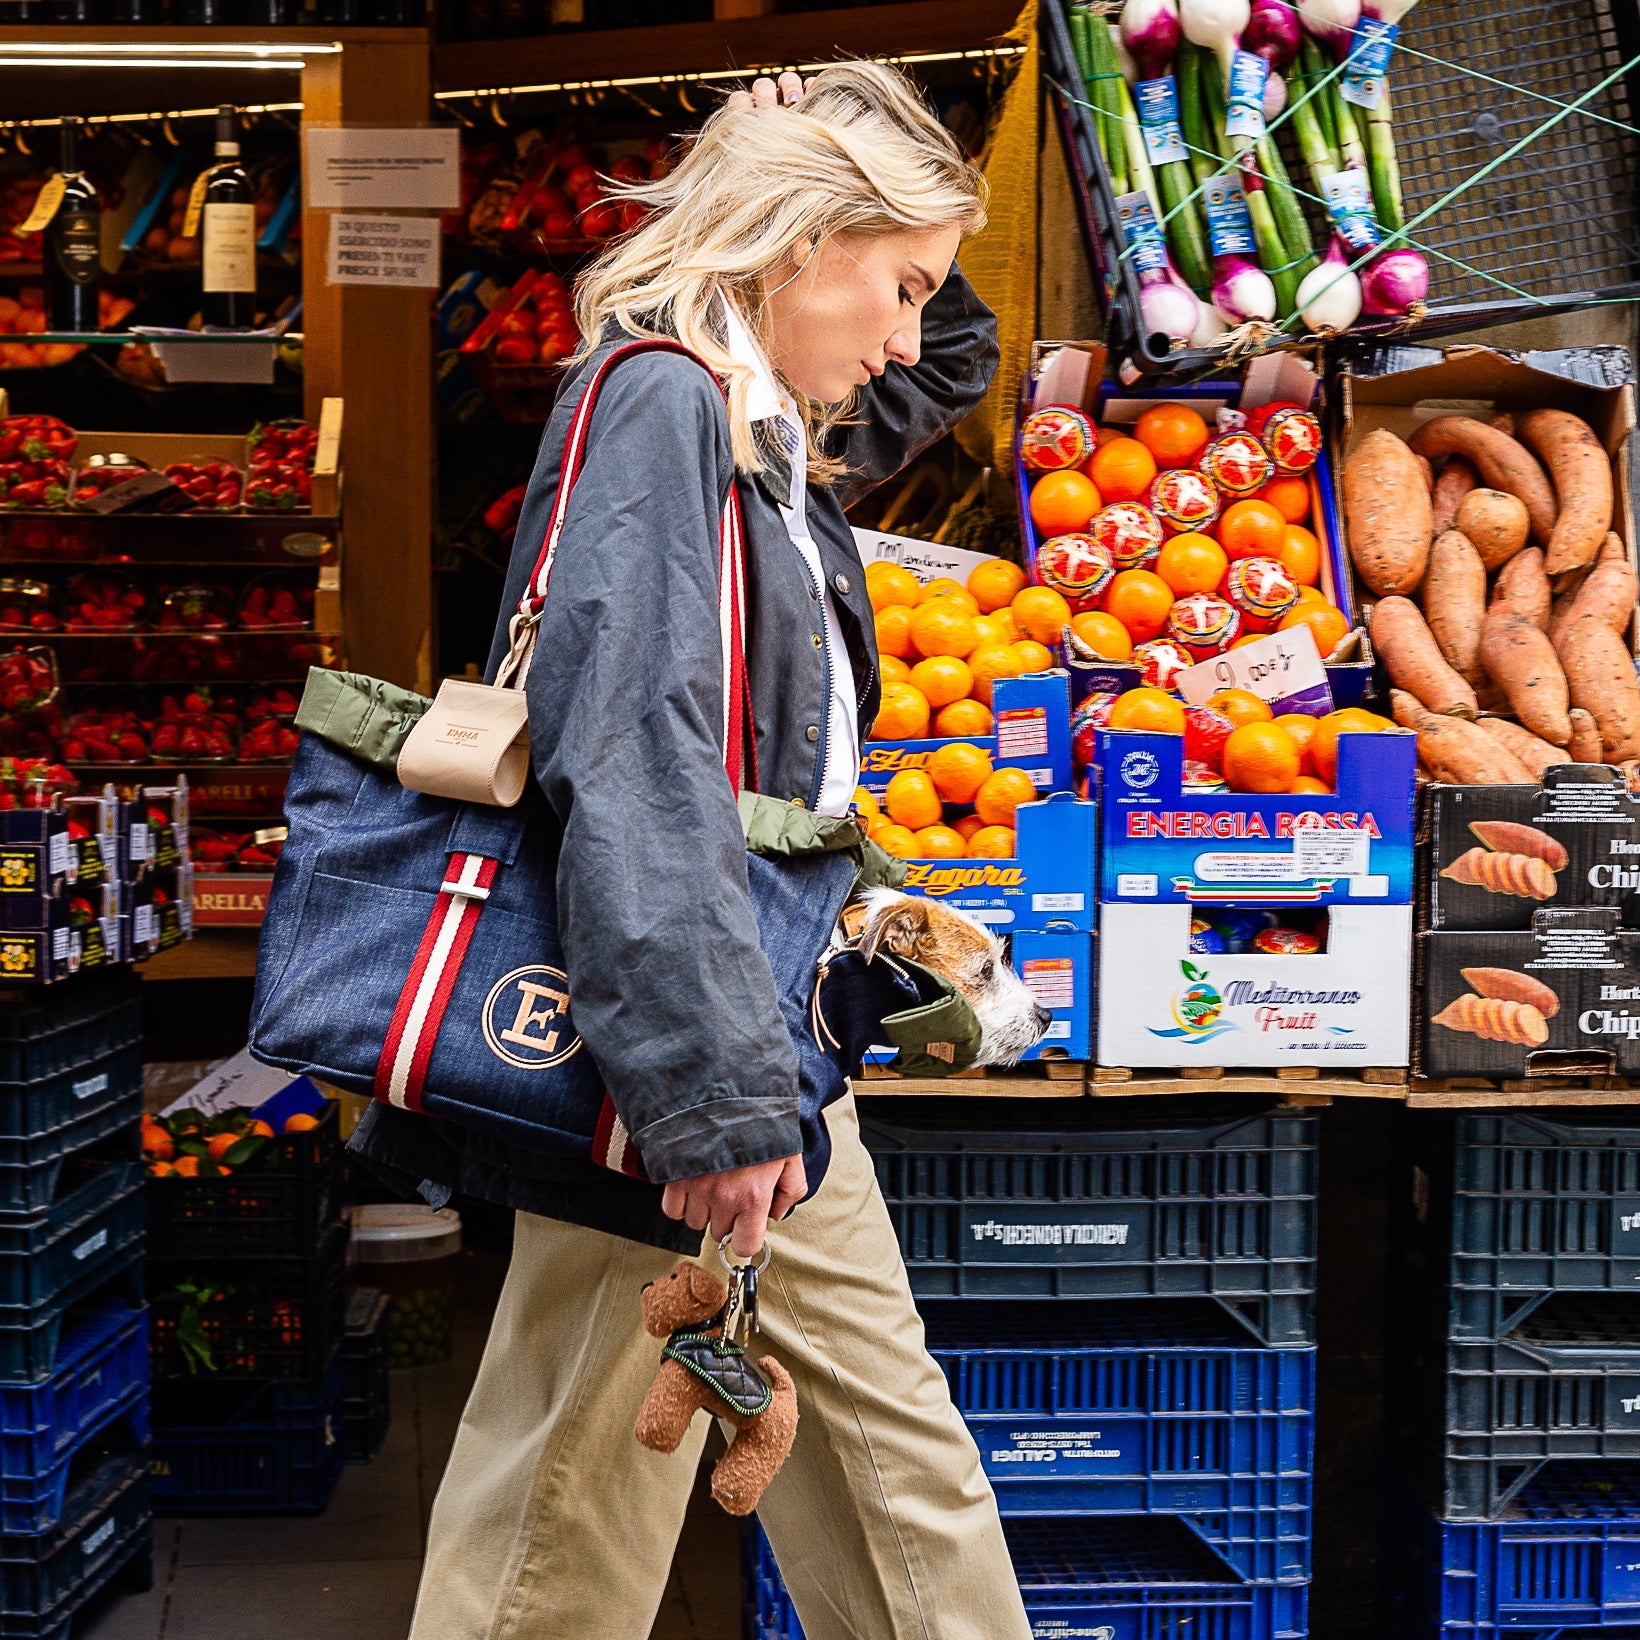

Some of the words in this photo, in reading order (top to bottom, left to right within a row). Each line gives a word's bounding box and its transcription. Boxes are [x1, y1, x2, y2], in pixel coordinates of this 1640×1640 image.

[446, 728, 479, 740] EMMA
[1126, 810, 1271, 838] ENERGIA
[1275, 810, 1383, 838] ROSSA
[903, 863, 1027, 896] Zagara
[1223, 980, 1363, 1006] Mediterraneo
[1254, 1006, 1320, 1032] Fruit
[1002, 1225, 1063, 1245] BONECHI
[1063, 1224, 1129, 1245] AGRICOLA
[991, 1449, 1057, 1461] CALUGI
[1062, 1450, 1121, 1458] ORTOFRUTTA
